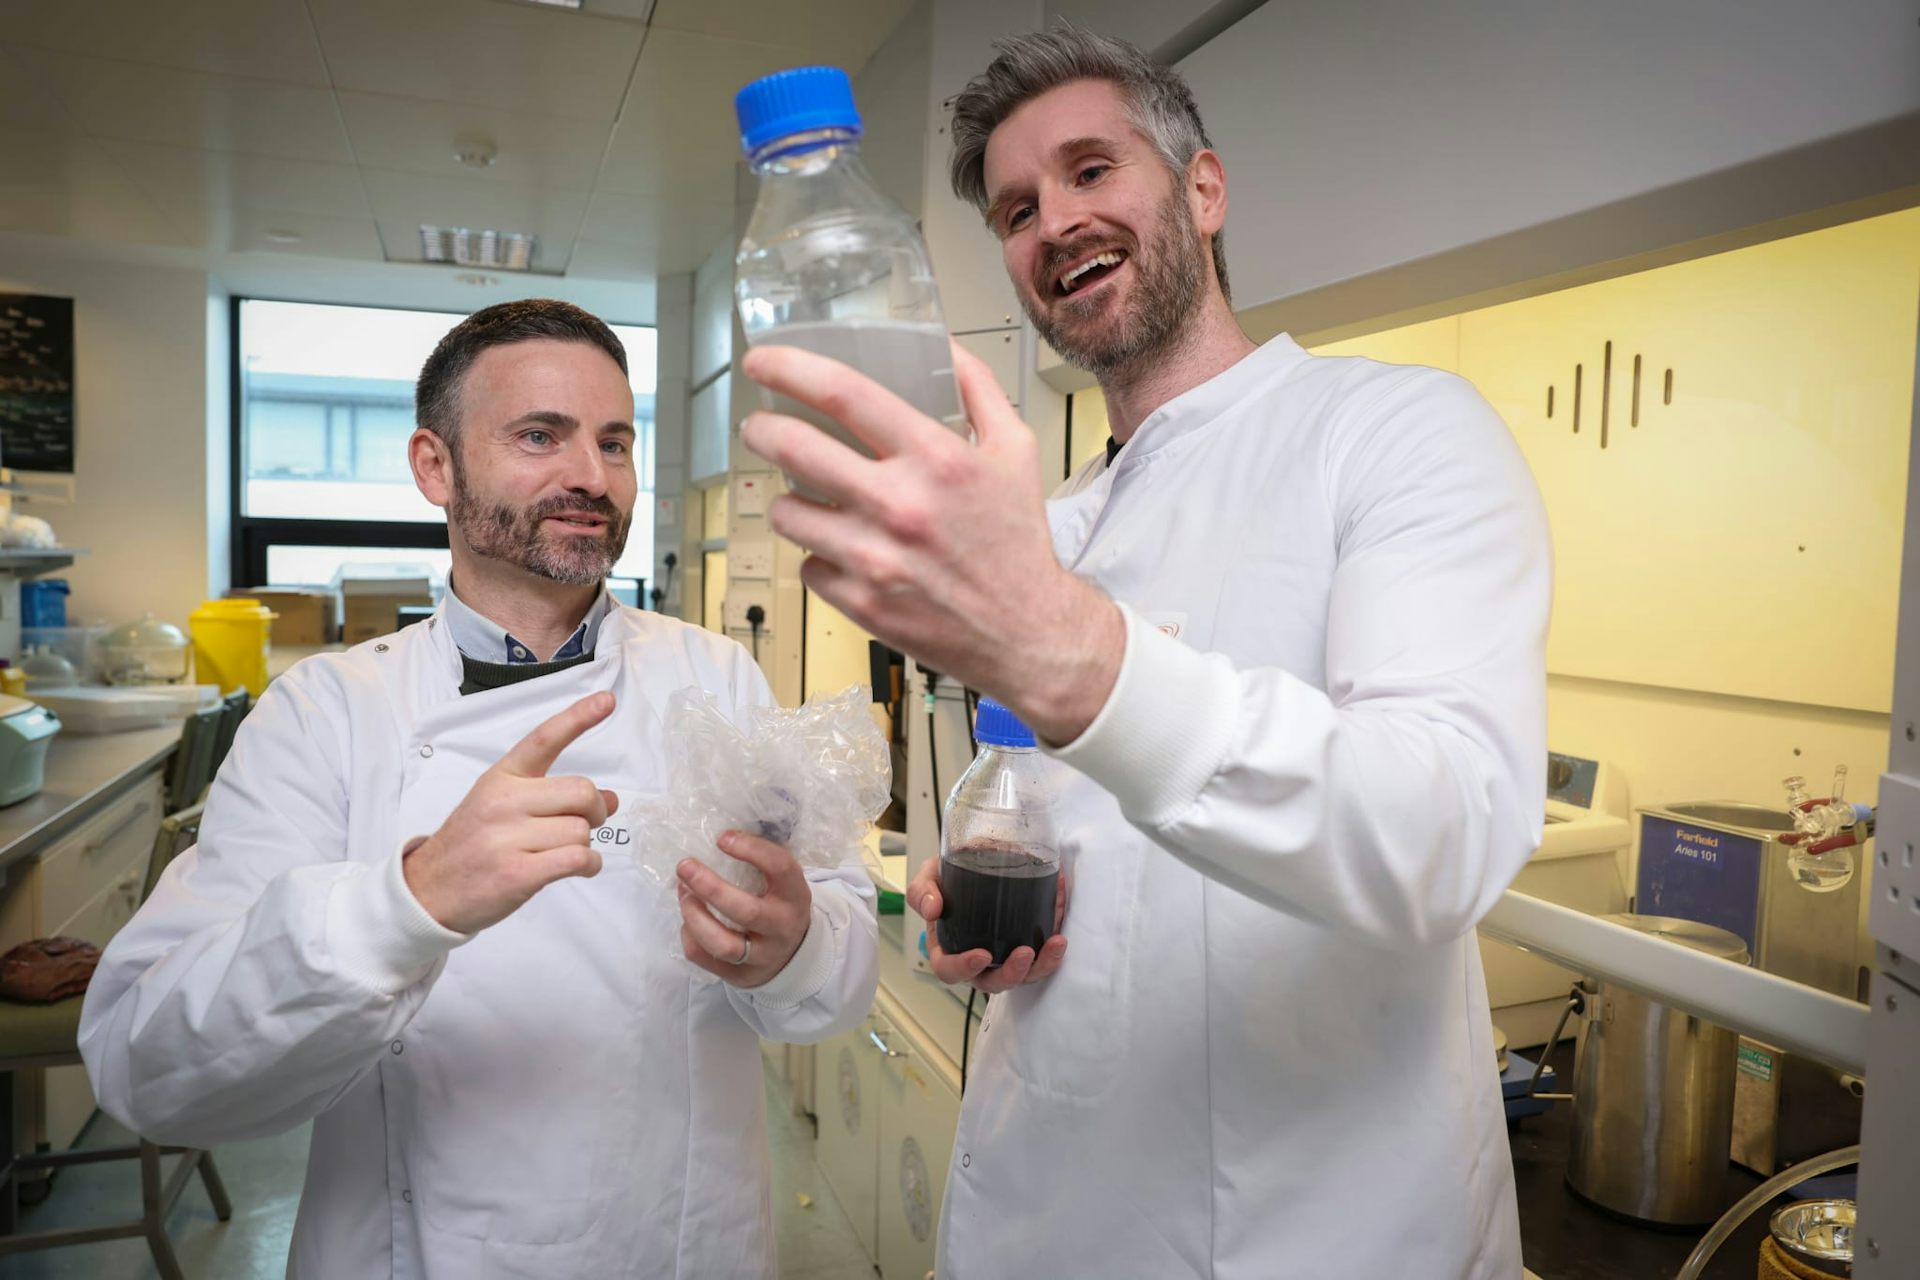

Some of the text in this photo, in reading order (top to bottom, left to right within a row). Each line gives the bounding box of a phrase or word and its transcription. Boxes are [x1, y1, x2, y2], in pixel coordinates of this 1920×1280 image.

[590, 826, 631, 845] @D
[1674, 843, 1717, 863] Aries 101
